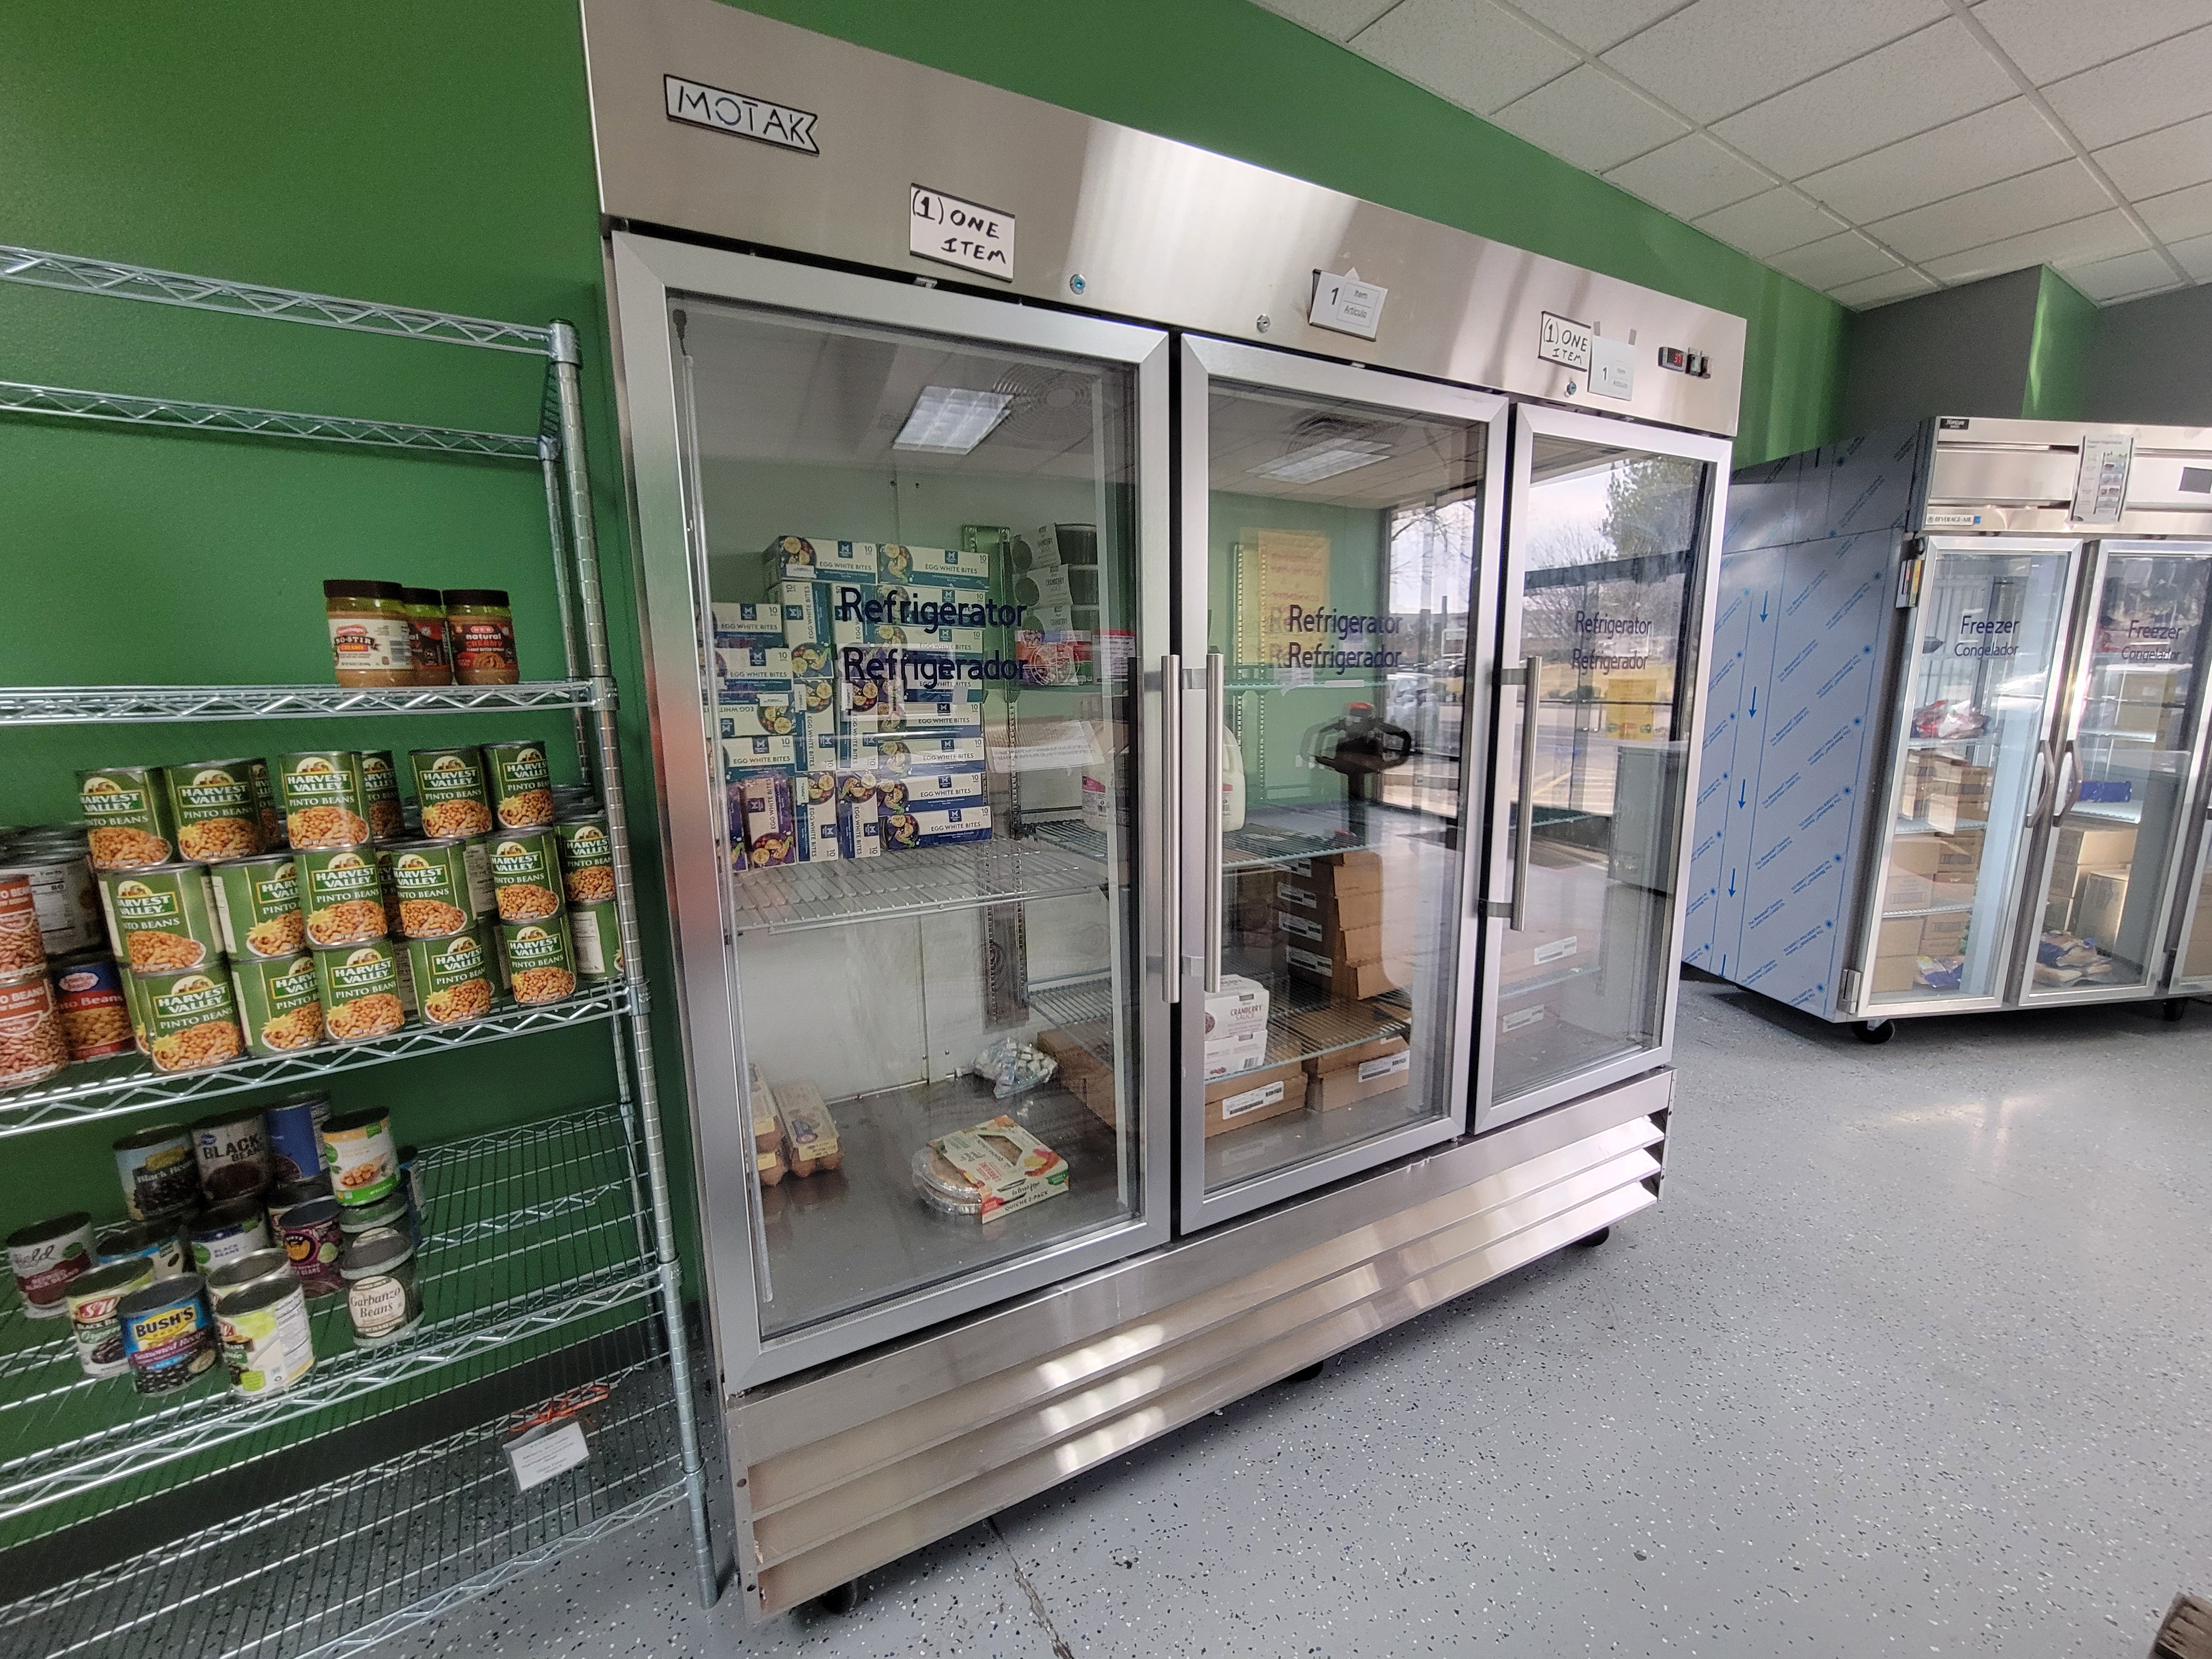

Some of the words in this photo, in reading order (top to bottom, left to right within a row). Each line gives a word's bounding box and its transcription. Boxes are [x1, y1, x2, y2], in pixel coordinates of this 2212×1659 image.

[678, 85, 805, 144] MOTAK
[913, 190, 944, 224] (1)
[950, 210, 1000, 239] ONE
[941, 238, 1006, 264] ITEM
[1331, 287, 1339, 305] 1
[1543, 318, 1559, 345] (1)
[1561, 330, 1588, 352] ONE
[1552, 348, 1582, 365] ITEM
[1602, 367, 1607, 381] 1
[841, 587, 1028, 634] Refrigerator
[1289, 603, 1402, 640] Refrigerator
[1575, 610, 1653, 639] Refrigerator
[1960, 615, 2020, 634] Freezer
[2128, 619, 2183, 640] Freezer
[1954, 642, 2019, 659] Congelador
[2121, 646, 2182, 661] Congelador
[1288, 641, 1402, 676] Refrigerador
[1572, 648, 1649, 676] Refrigerador
[843, 646, 1029, 690] Refrigerador
[287, 774, 348, 785] HARVEST
[424, 769, 477, 781] HARVEST
[431, 777, 472, 787] VALLEY
[181, 785, 247, 797] HARVEST
[294, 782, 344, 792] VALLEY
[507, 783, 535, 791] PINTO
[189, 794, 244, 804] VALLEY
[289, 798, 318, 807] PINTO
[322, 795, 354, 804] BEANS
[425, 791, 454, 800] PINTO
[456, 789, 482, 798] BEANS
[109, 815, 149, 825] BEANS
[183, 809, 219, 819] PINTO
[316, 867, 374, 881] HARVEST
[495, 862, 534, 872] VALLEY
[324, 876, 372, 888] VALLEY
[515, 873, 545, 883] BEANS
[317, 893, 351, 903] PINTO
[419, 888, 449, 898] BEANS
[140, 918, 180, 929] BEANS
[510, 937, 558, 949] HARVEST
[436, 947, 482, 964] HARVEST
[516, 946, 554, 956] VALLEY
[444, 956, 481, 970] VALLEY
[512, 960, 535, 968] PINTO
[538, 954, 563, 966] BEANS
[335, 961, 392, 977] HARVEST
[343, 970, 389, 984] VALLEY
[436, 974, 467, 985] PINTO
[158, 985, 227, 1007] HARVEST
[335, 988, 370, 999] PINTO
[168, 995, 222, 1014] VALLEY
[276, 996, 311, 1010] PINTO
[1231, 1005, 1262, 1015] CRANBERRY
[160, 1015, 200, 1029] PINTO
[203, 1133, 259, 1160] BLACK
[351, 1287, 400, 1307] Garbanzo
[360, 1301, 393, 1318] Beans
[136, 1307, 194, 1338] BUSH'S
